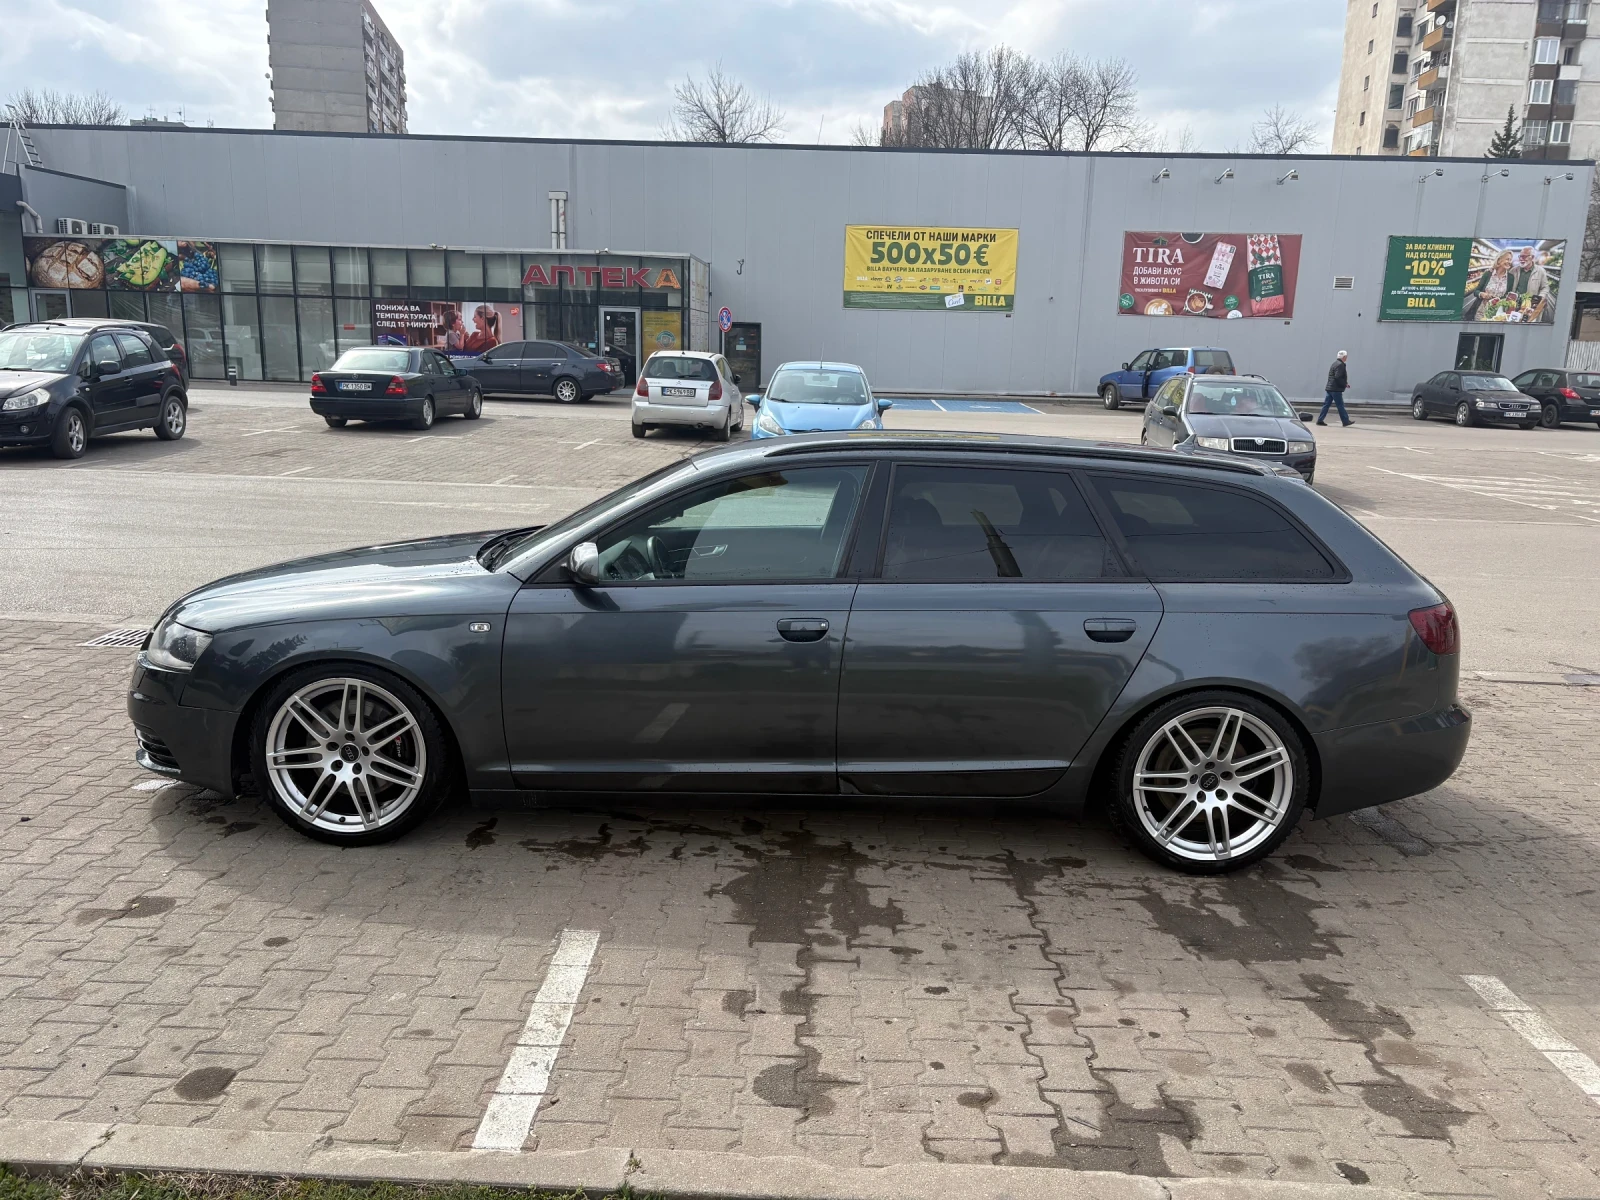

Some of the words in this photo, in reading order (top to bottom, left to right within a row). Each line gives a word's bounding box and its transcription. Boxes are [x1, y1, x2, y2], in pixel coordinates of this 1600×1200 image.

[866, 230, 911, 241] СПЕЧЕЛИ
[913, 231, 926, 241] ОТ
[929, 231, 959, 242] НАШИ
[960, 232, 996, 243] МАРКИ
[1132, 247, 1185, 265] TIRA
[1133, 266, 1162, 276] ДОБАВИ
[1163, 267, 1182, 276] ВКУС
[1405, 260, 1445, 275] -10%
[522, 263, 681, 289] АПТЕКА
[1133, 276, 1138, 285] В
[1139, 276, 1169, 286] ЖИВОТА
[1170, 277, 1181, 286] СИ
[1257, 272, 1275, 280] TIRA
[974, 295, 1006, 307] BILLA
[1407, 297, 1436, 308] BILLA
[376, 312, 436, 320] ТЕМПЕРАТУРАТА
[376, 320, 397, 328] СЛЕД
[406, 321, 438, 329] МИНУТИ
